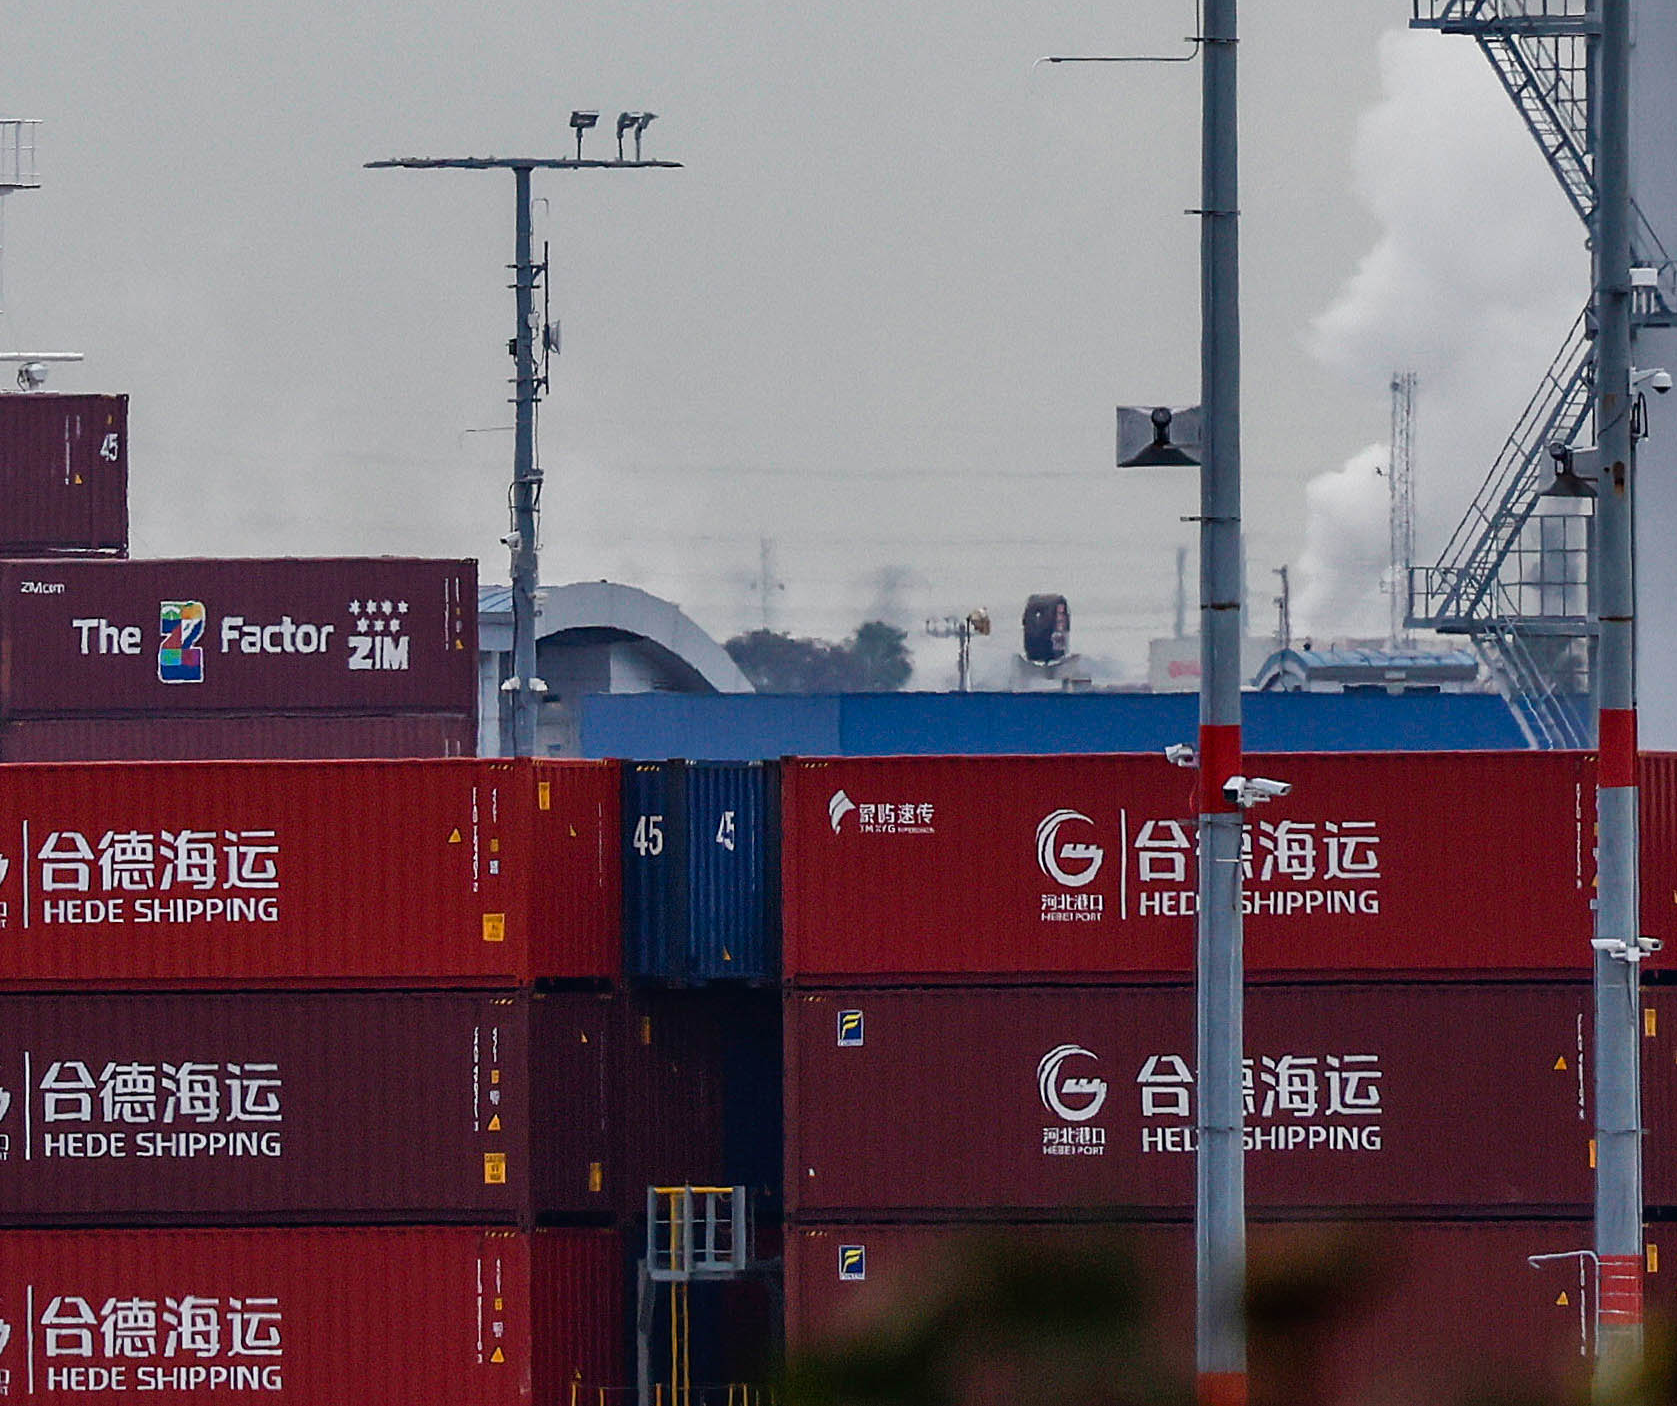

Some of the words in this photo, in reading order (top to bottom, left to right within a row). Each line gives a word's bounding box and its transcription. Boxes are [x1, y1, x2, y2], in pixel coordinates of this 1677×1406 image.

[100, 433, 119, 462] 45
[72, 618, 143, 656] The
[220, 615, 335, 654] Factor
[347, 635, 410, 671] ZIM
[633, 815, 663, 857] 45
[716, 811, 735, 851] 45
[37, 829, 280, 892] 台德海运
[44, 899, 126, 924] HEDE
[134, 897, 279, 924] SHIPPING
[1041, 894, 1103, 911] 河北港口
[1140, 891, 1199, 916] HED
[1242, 890, 1380, 916] SHIPPING
[39, 1061, 283, 1123] 台德海运
[44, 1133, 126, 1157] HEDE
[135, 1132, 281, 1157] SHIPPING
[1043, 1127, 1105, 1144] 河北港口
[1243, 1126, 1381, 1151] SHIPPING
[41, 1296, 283, 1357] 台德海运
[48, 1366, 126, 1390] HEDE
[136, 1366, 283, 1390] SHIPPING
